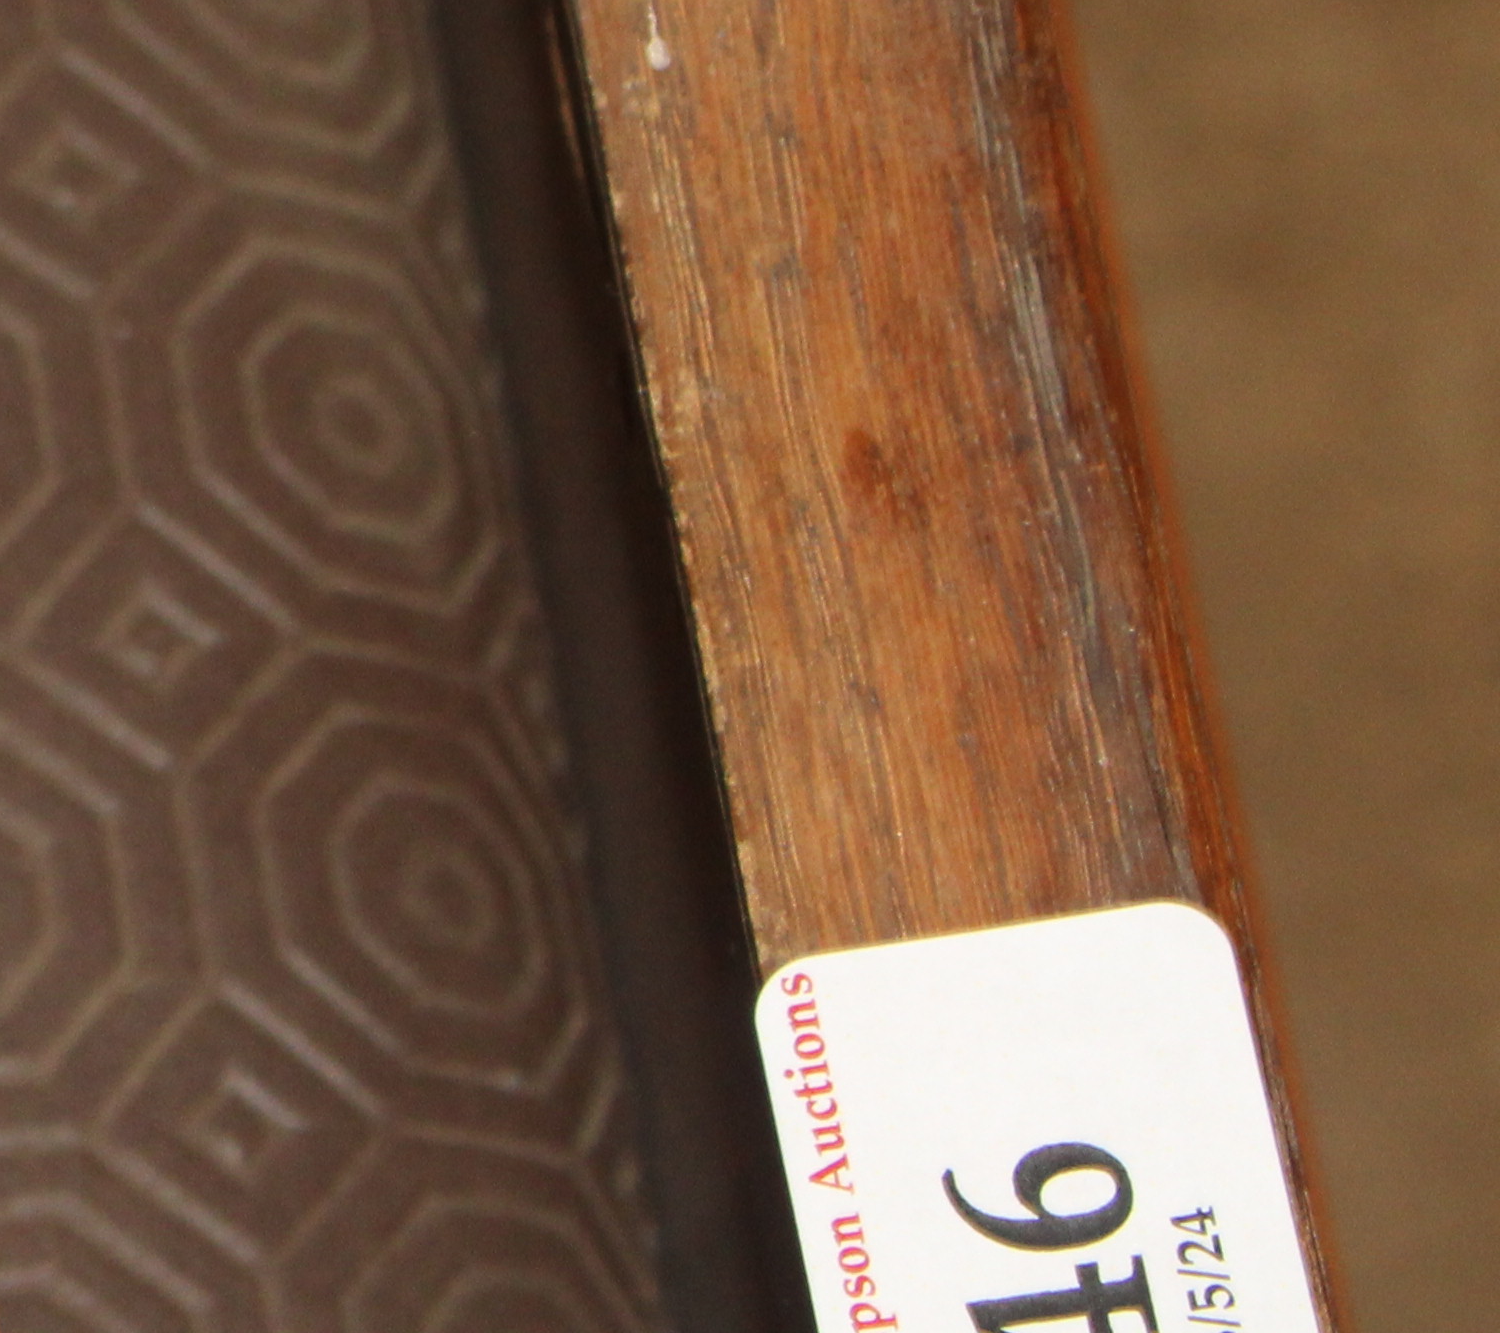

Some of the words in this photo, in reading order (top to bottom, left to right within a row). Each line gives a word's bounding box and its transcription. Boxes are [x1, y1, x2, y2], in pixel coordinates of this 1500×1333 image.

[781, 971, 855, 1195] Auctions
[830, 1213, 900, 1333] pson
[1169, 1205, 1243, 1333] /5/24
